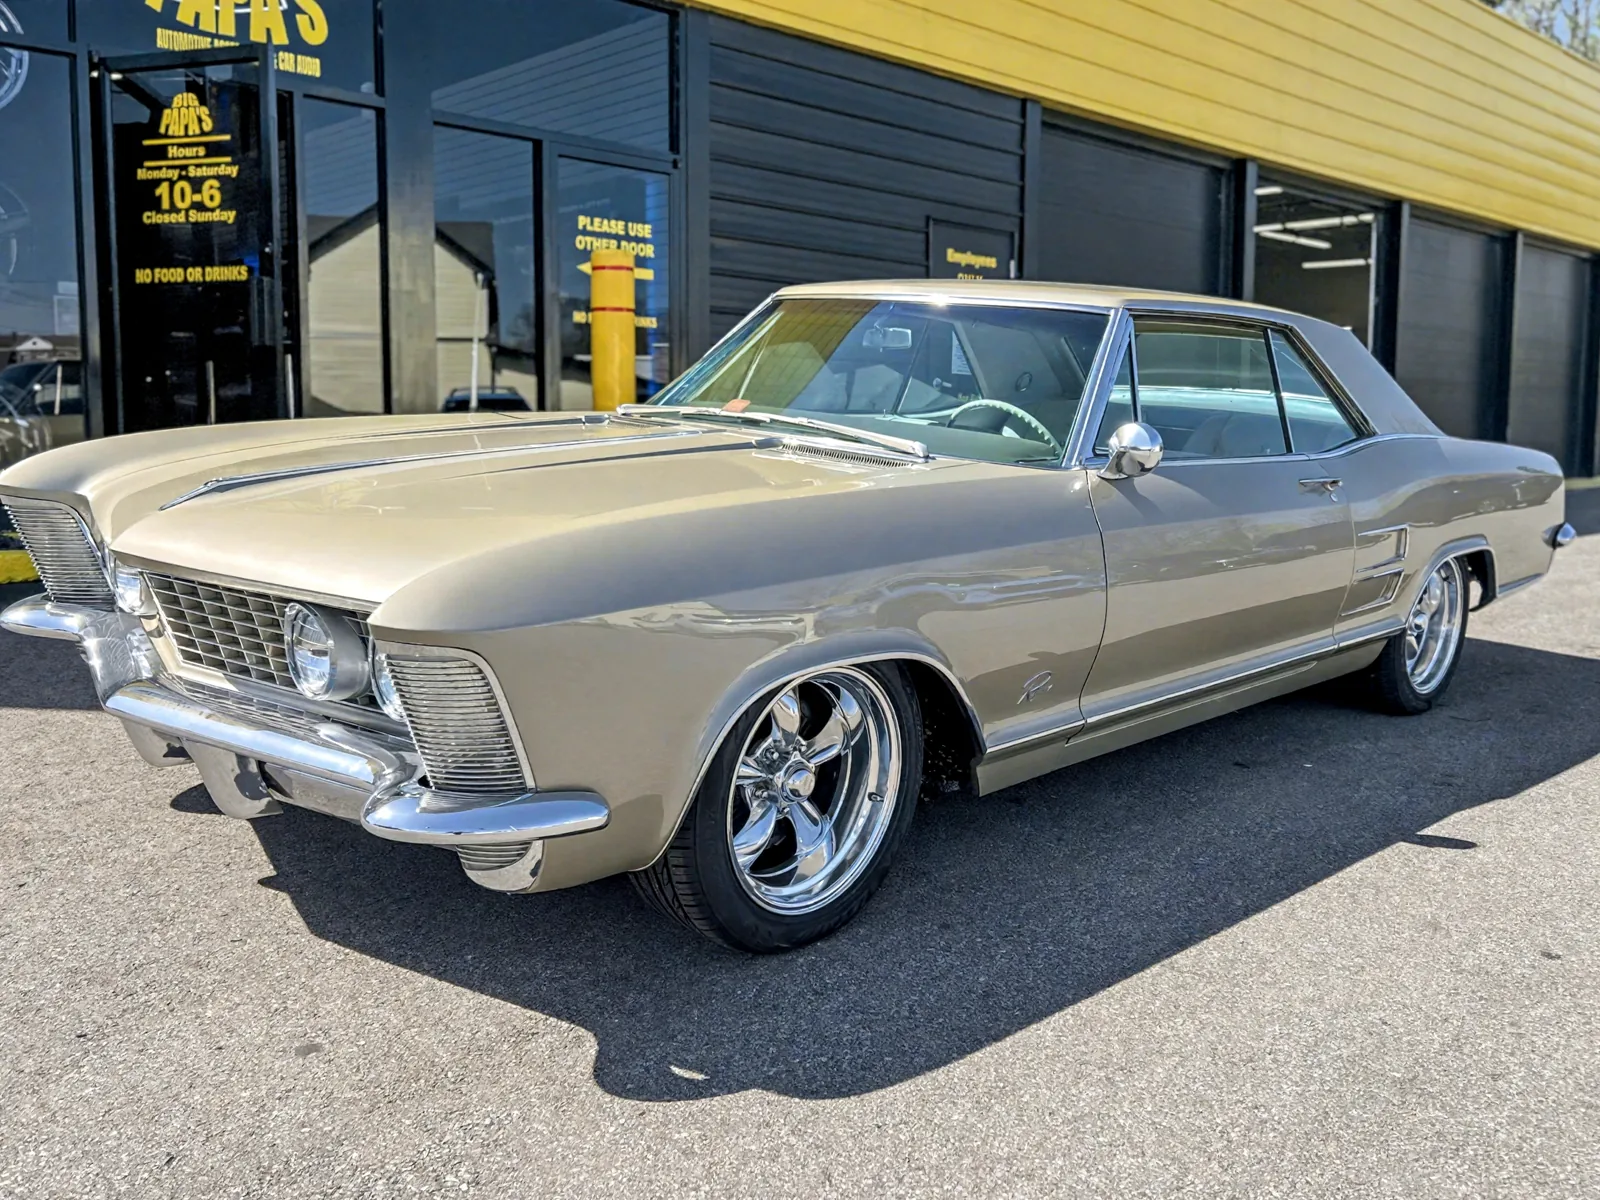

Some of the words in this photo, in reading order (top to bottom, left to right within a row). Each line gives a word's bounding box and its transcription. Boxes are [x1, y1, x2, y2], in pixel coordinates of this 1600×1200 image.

[145, 0, 328, 46] APAS
[156, 27, 212, 51] AUTOMOTIVE
[278, 51, 295, 73] CAR
[297, 54, 321, 78] AUDIO
[172, 92, 200, 108] BIG
[159, 105, 213, 136] PAPA'S
[167, 145, 206, 158] Hours
[137, 167, 180, 180] Monday
[188, 164, 239, 178] Saturday
[155, 179, 222, 210] 10-6
[142, 211, 186, 224] Closed
[188, 209, 236, 224] Sunday
[578, 215, 626, 236] PLEASE
[627, 222, 652, 239] USE
[575, 235, 618, 251] OTHER
[620, 240, 655, 258] DOOR
[135, 268, 152, 284] NO
[154, 267, 185, 283] FOOD
[186, 266, 203, 282] OR
[204, 265, 248, 282] DRINKS
[572, 310, 587, 324] NO
